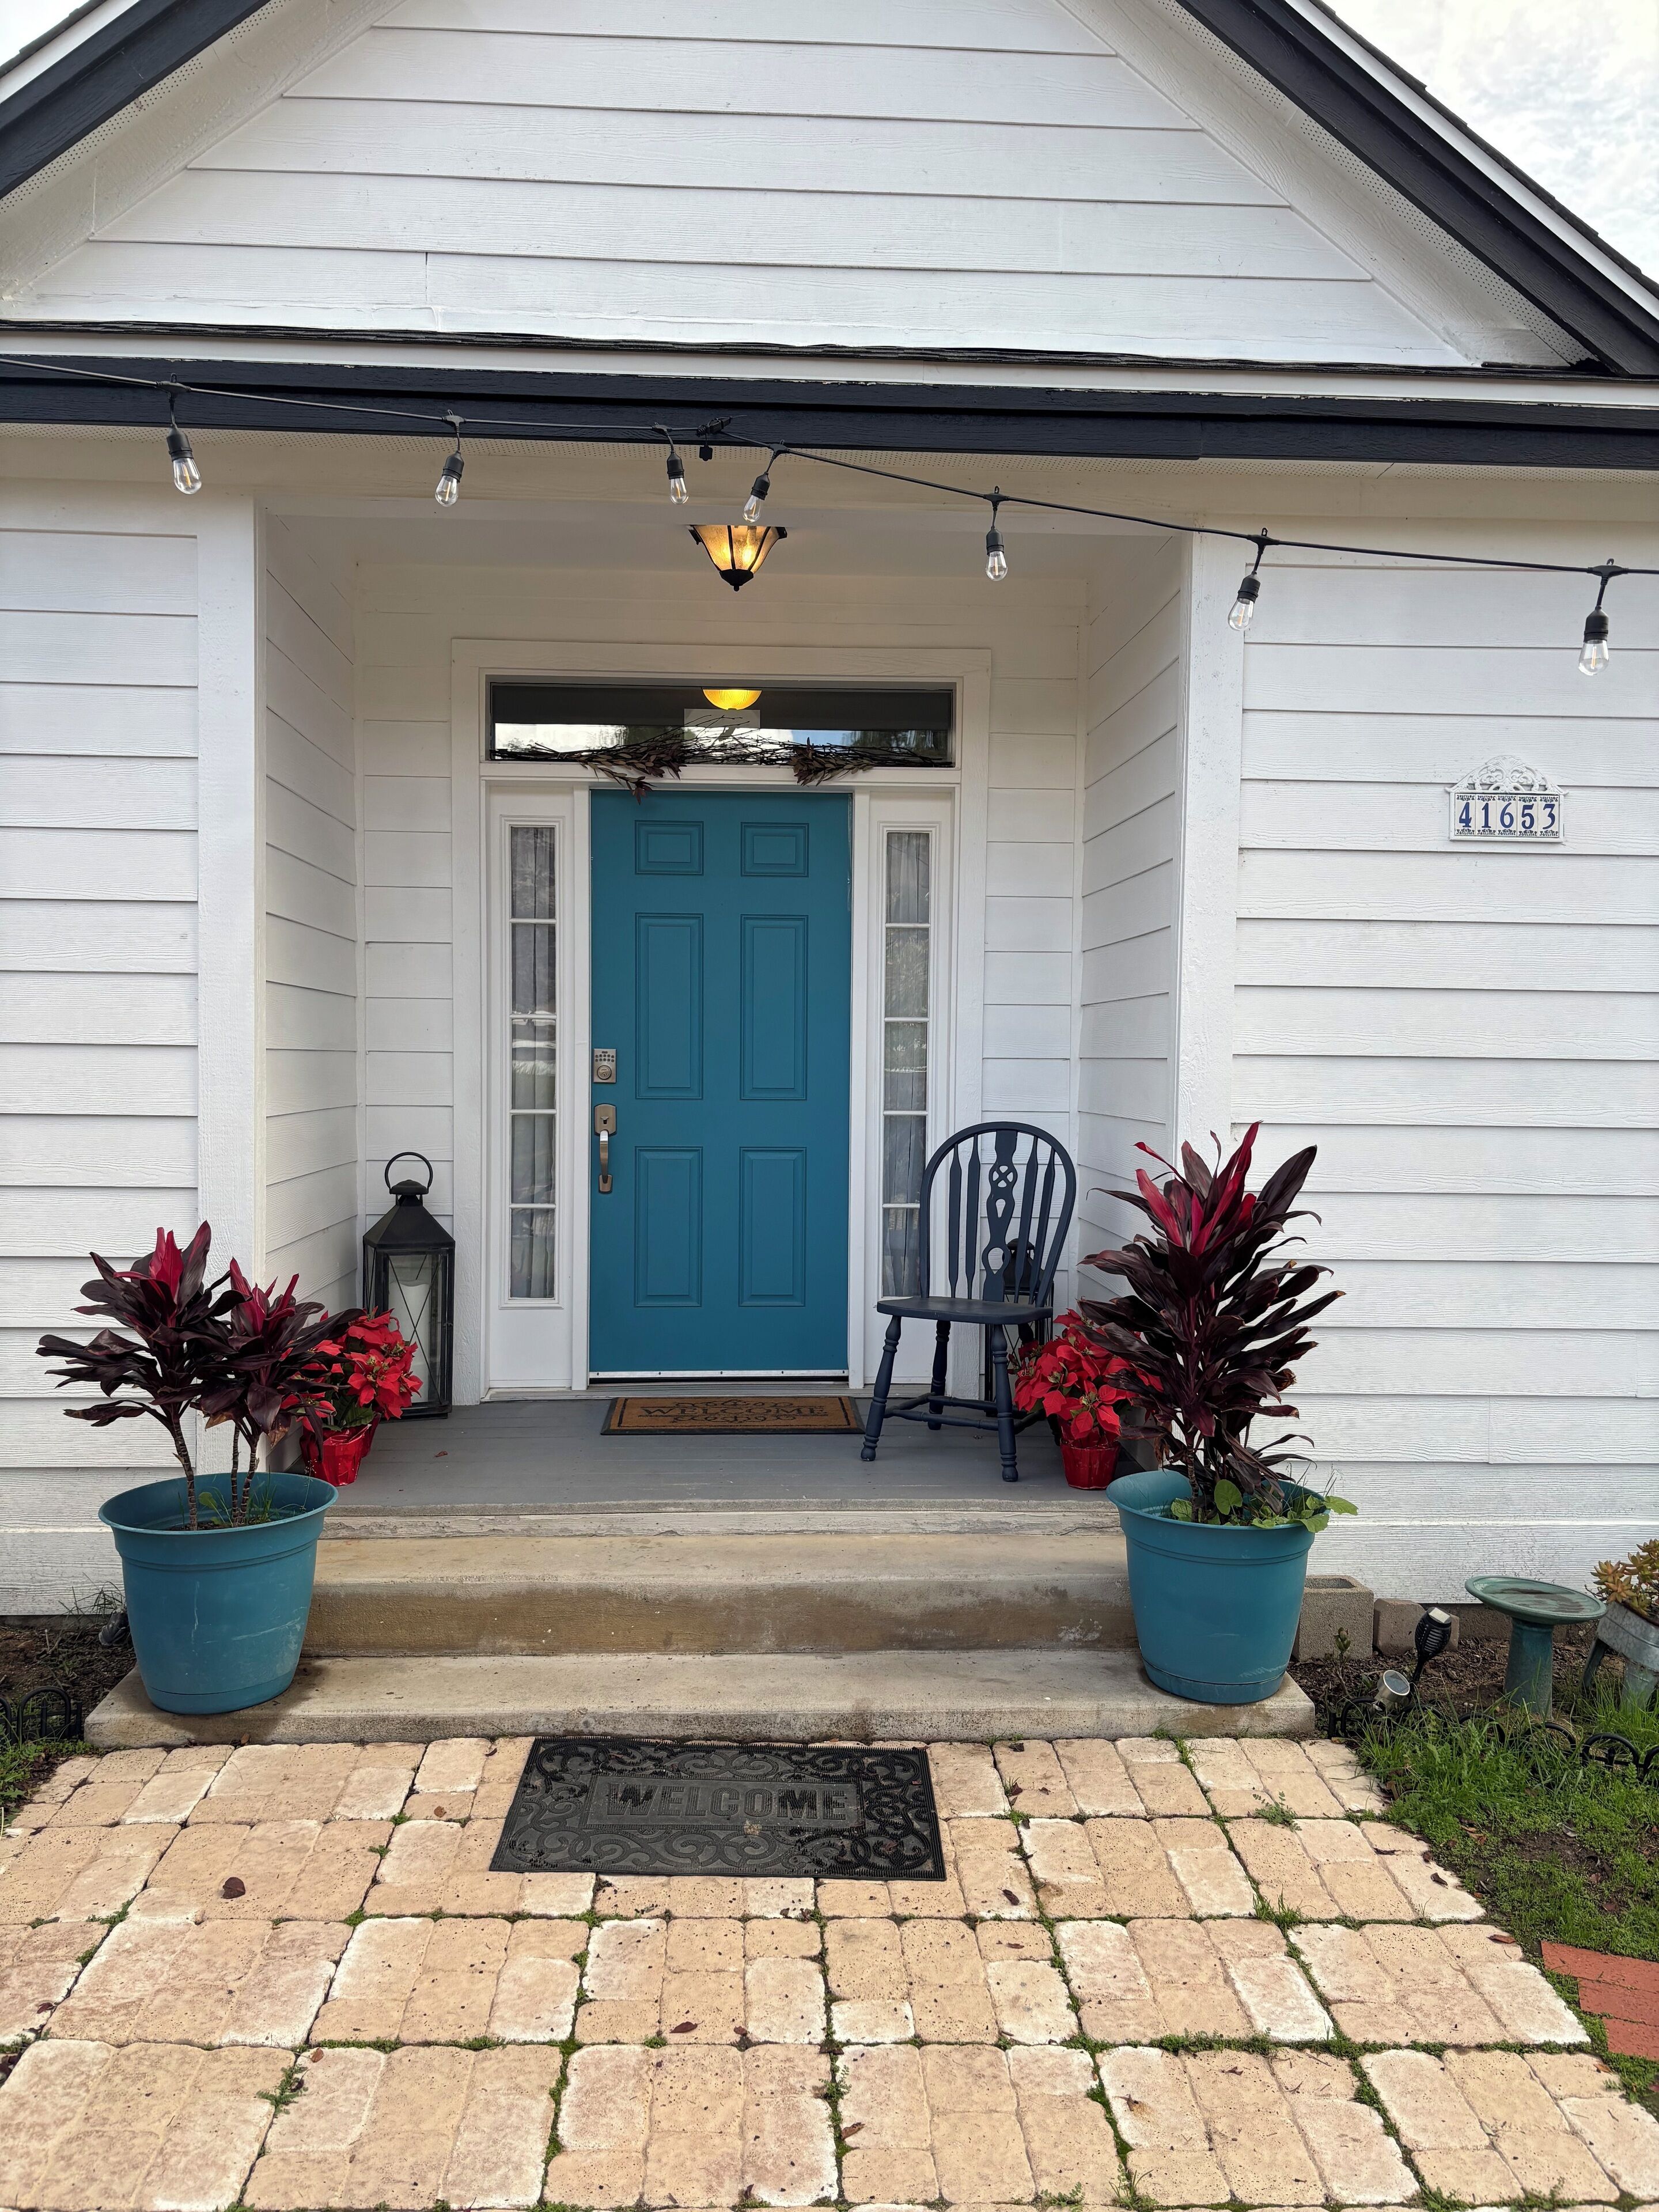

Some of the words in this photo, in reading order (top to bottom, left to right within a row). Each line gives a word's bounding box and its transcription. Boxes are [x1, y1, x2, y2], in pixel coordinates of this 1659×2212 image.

[1458, 802, 1556, 830] 41653
[642, 1407, 828, 1416] WELCOME
[607, 1782, 847, 1820] WELCOME
